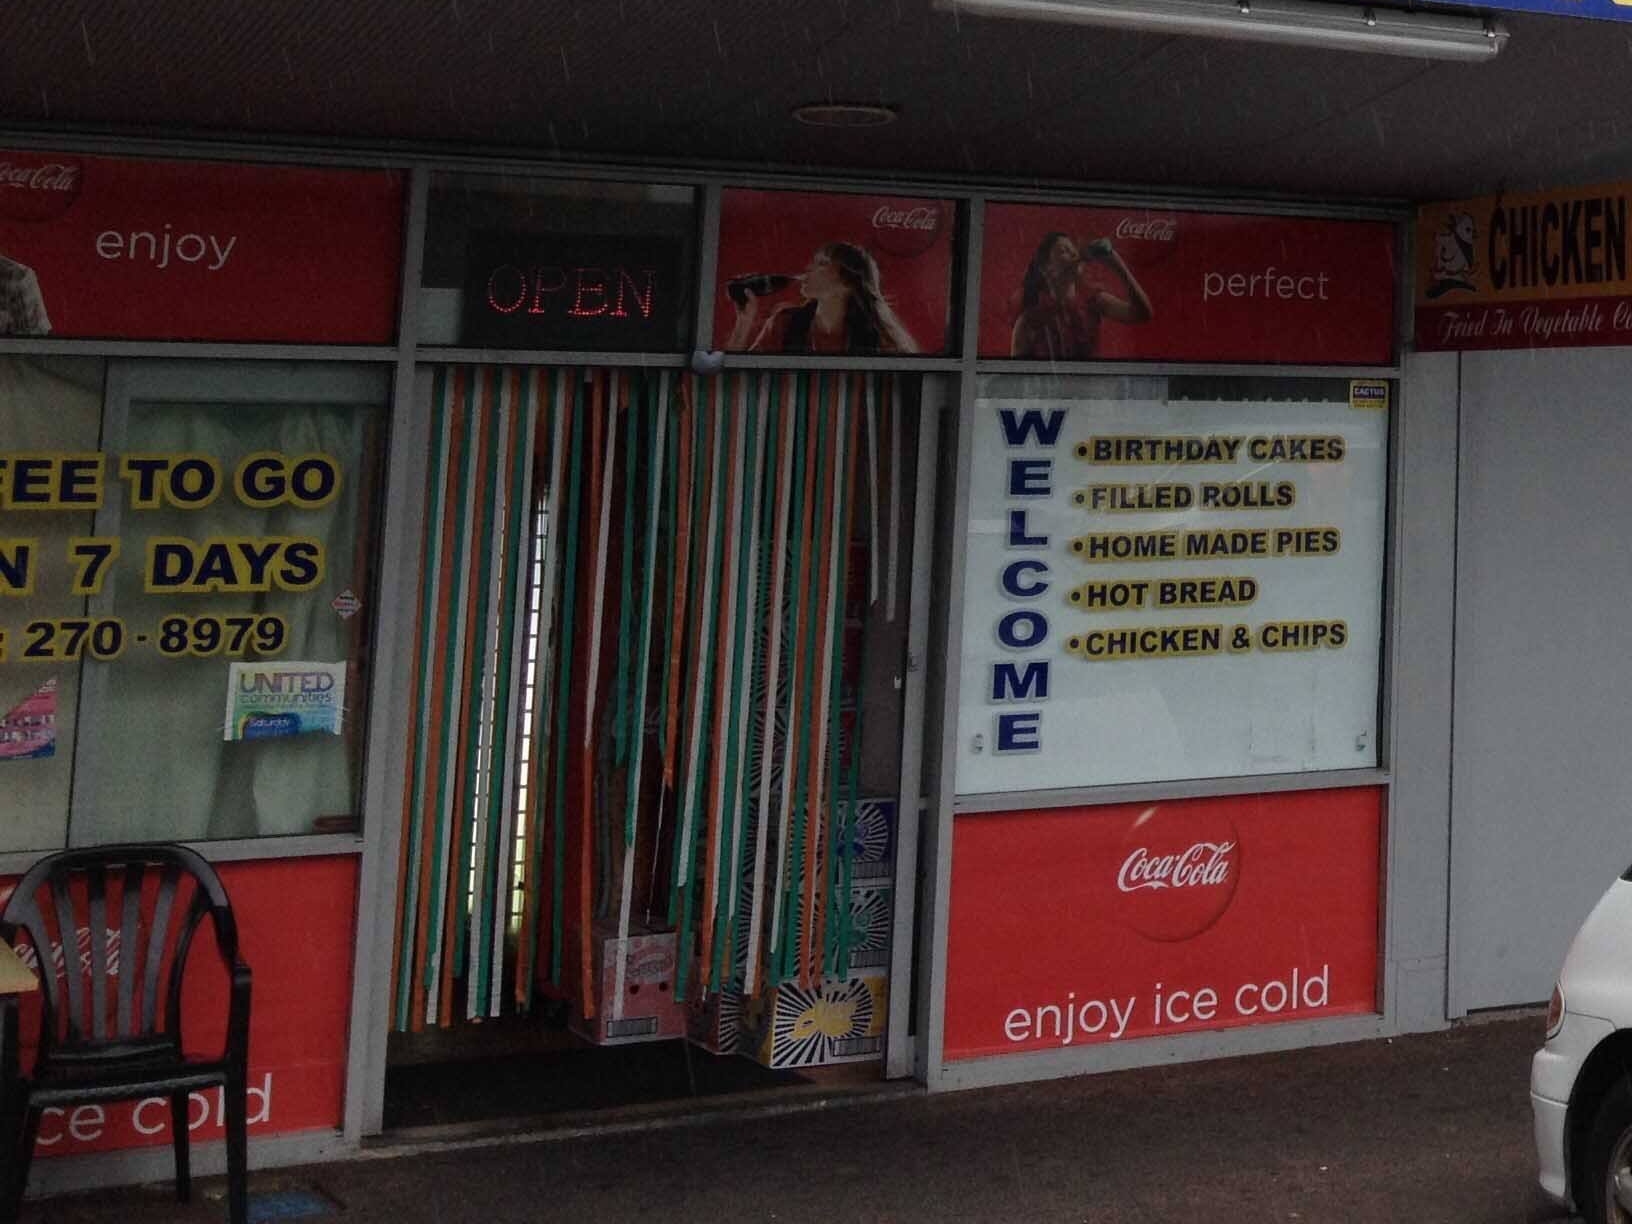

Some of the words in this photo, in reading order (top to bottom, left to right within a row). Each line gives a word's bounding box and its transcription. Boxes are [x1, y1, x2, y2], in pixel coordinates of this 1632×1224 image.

[95, 223, 238, 271] enjoy
[1487, 194, 1627, 291] CHICKEN
[486, 265, 656, 319] OPEN
[1202, 265, 1330, 303] perfect
[1438, 306, 1487, 345] Fried
[1519, 302, 1604, 342] Vegetable
[1093, 438, 1241, 462] BIRTHDAY
[1249, 435, 1344, 461] CAKES
[0, 459, 99, 503] EE
[127, 458, 217, 503] TO
[241, 458, 337, 503] GO
[1090, 484, 1193, 510] FILLED
[1201, 483, 1295, 508] ROLLS
[74, 544, 113, 588] 7
[151, 542, 320, 586] DAYS
[1088, 534, 1176, 559] HOME
[1185, 531, 1267, 556] MADE
[1276, 529, 1340, 555] PIES
[991, 407, 1068, 753] WELCOME
[1086, 581, 1149, 607] HOT
[1158, 579, 1257, 605] BREAD
[1085, 626, 1222, 656] CHICKEN
[1230, 626, 1251, 650] &
[1260, 623, 1347, 648] CHIPS
[240, 672, 335, 695] UNITED
[1115, 839, 1238, 894] Coca-Cola
[1003, 991, 1137, 1046] enjoy
[1153, 982, 1218, 1026] ice
[1234, 964, 1330, 1018] cold
[36, 1103, 106, 1146] ce
[132, 1072, 273, 1137] cold
